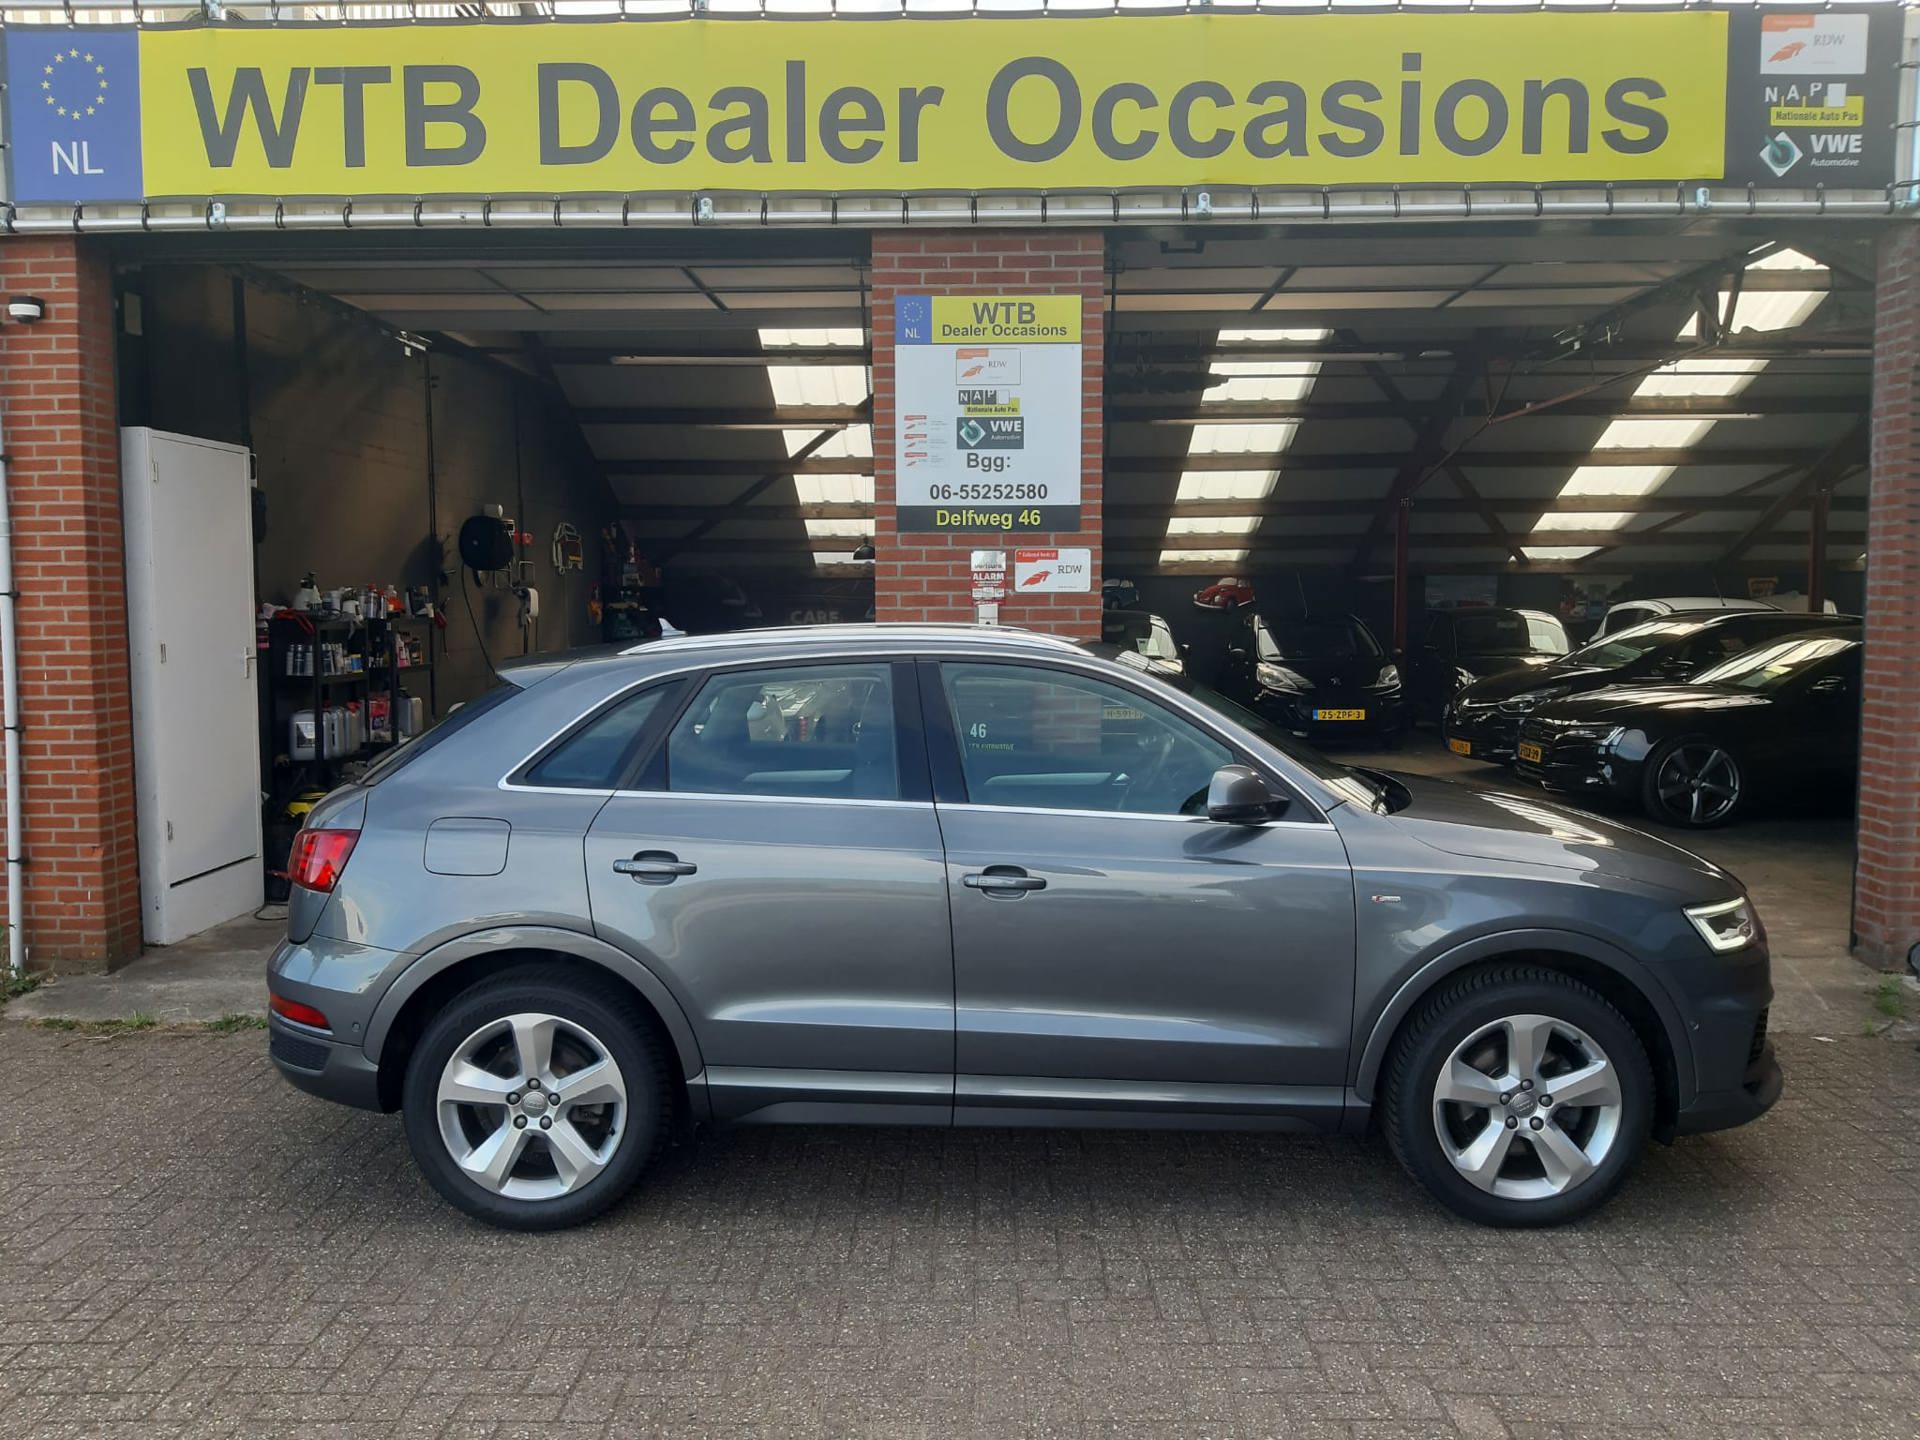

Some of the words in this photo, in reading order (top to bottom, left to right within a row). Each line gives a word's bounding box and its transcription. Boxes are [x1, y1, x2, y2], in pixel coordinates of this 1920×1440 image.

[1813, 34, 1845, 47] RDW
[186, 64, 487, 168] WTB
[537, 60, 945, 165] Dealer
[986, 52, 1669, 162] Occasions
[1819, 111, 1840, 121] Auto
[1810, 134, 1863, 154] VWE
[51, 141, 104, 175] NL
[1810, 158, 1860, 167] Automotive
[972, 302, 1036, 324] WTB
[904, 327, 920, 339] NL
[942, 324, 987, 337] Dealer
[992, 324, 1067, 337] Occasions
[990, 420, 1022, 432] VWE
[967, 452, 1011, 472] Bgg:
[929, 484, 1048, 500] 06-55252580
[936, 509, 1013, 529] Delfweg
[1018, 510, 1041, 526] 46
[1057, 565, 1082, 574] RDW
[969, 723, 987, 738] 46
